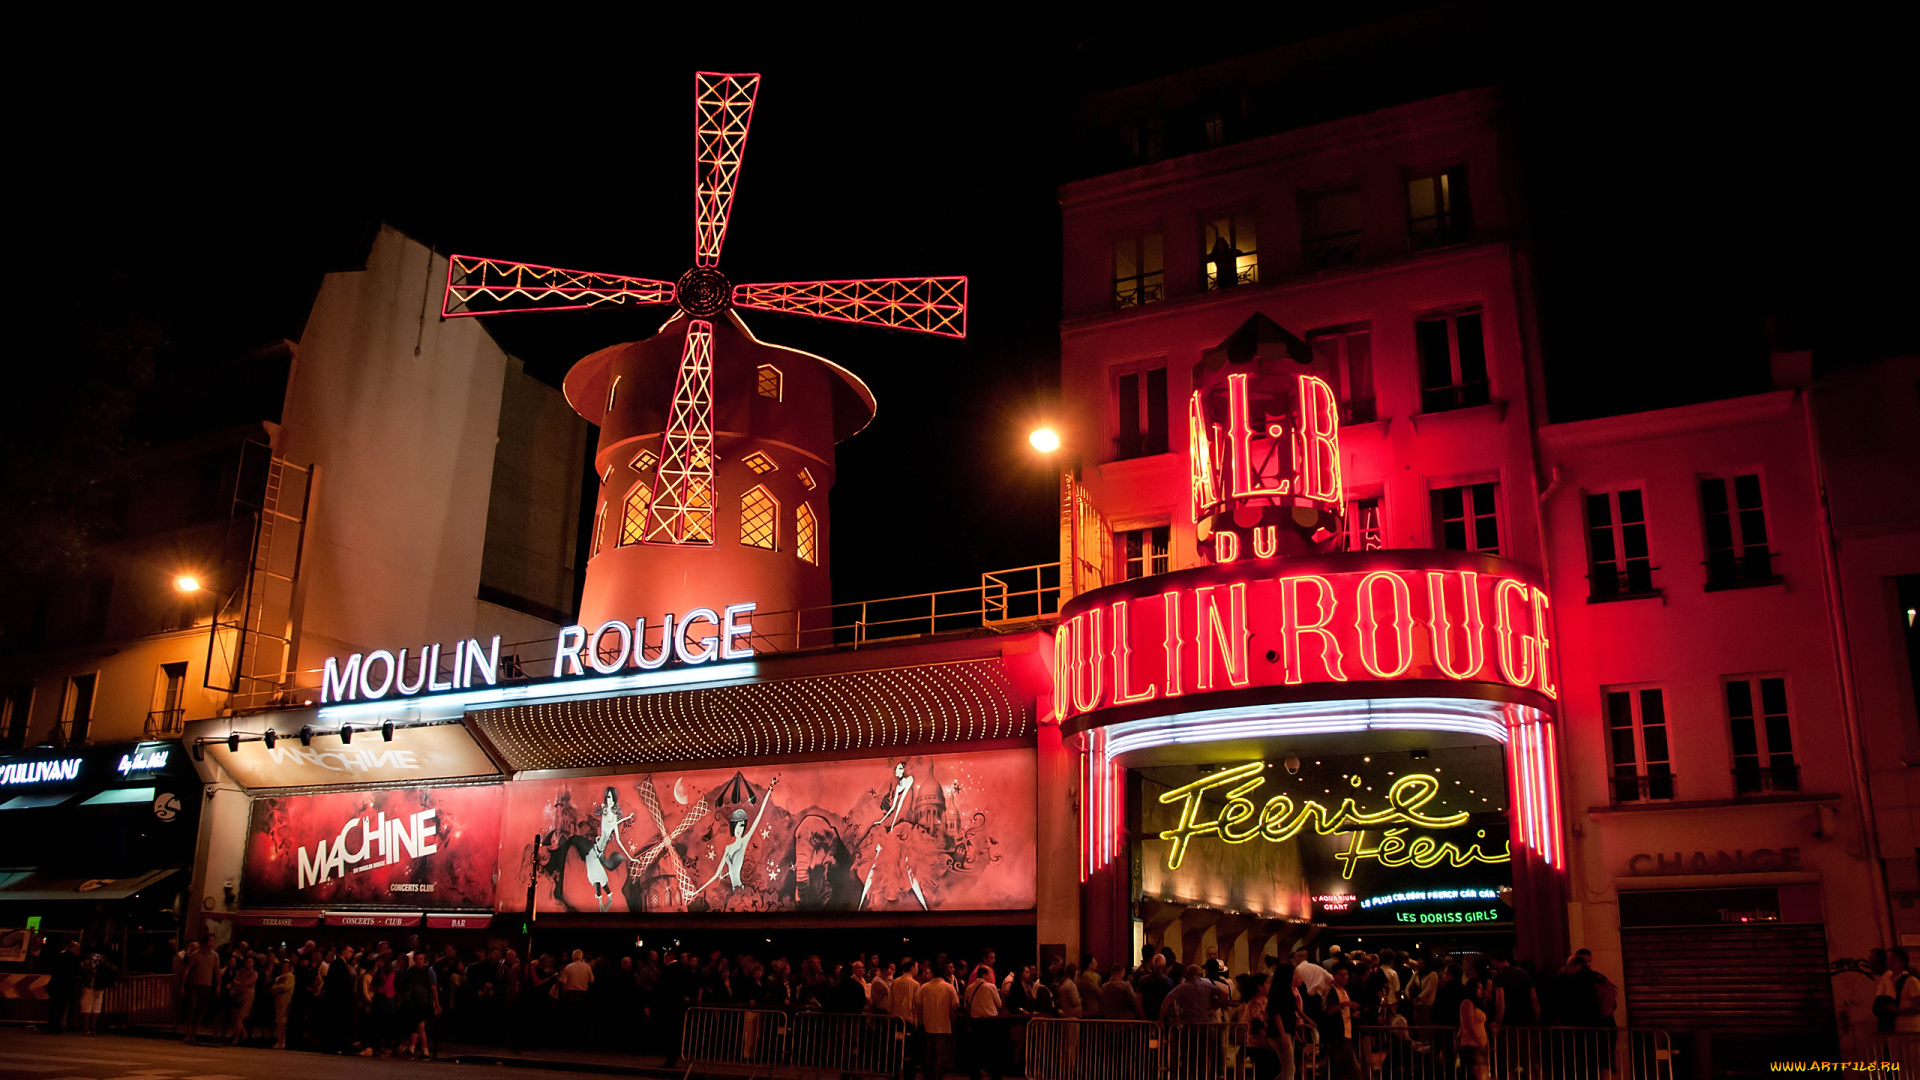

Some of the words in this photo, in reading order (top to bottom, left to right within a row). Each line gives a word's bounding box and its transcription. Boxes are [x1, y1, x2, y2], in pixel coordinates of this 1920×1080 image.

[1215, 525, 1277, 563] DU
[320, 635, 501, 703] MOULIN
[553, 602, 757, 678] ROUGE
[1054, 583, 1250, 723] OULIN
[1280, 571, 1557, 700] ROUGE
[1160, 762, 1470, 871] Féerie
[297, 808, 438, 890] MACHINE
[1335, 828, 1511, 880] Féeri
[1629, 847, 1802, 875] CHANGE
[391, 883, 419, 892] CONCERTS
[420, 884, 435, 892] CLUB
[1361, 900, 1371, 909] LE
[1373, 896, 1392, 906] PLUS
[1427, 890, 1459, 900] FRENCH
[1460, 889, 1477, 898] CAN
[342, 917, 375, 925] CONCERTS
[385, 917, 402, 925] CLUB
[451, 919, 466, 927] BAR
[1397, 912, 1416, 923] LES
[1421, 912, 1462, 923] DORISS
[1465, 909, 1498, 922] GIRLS
